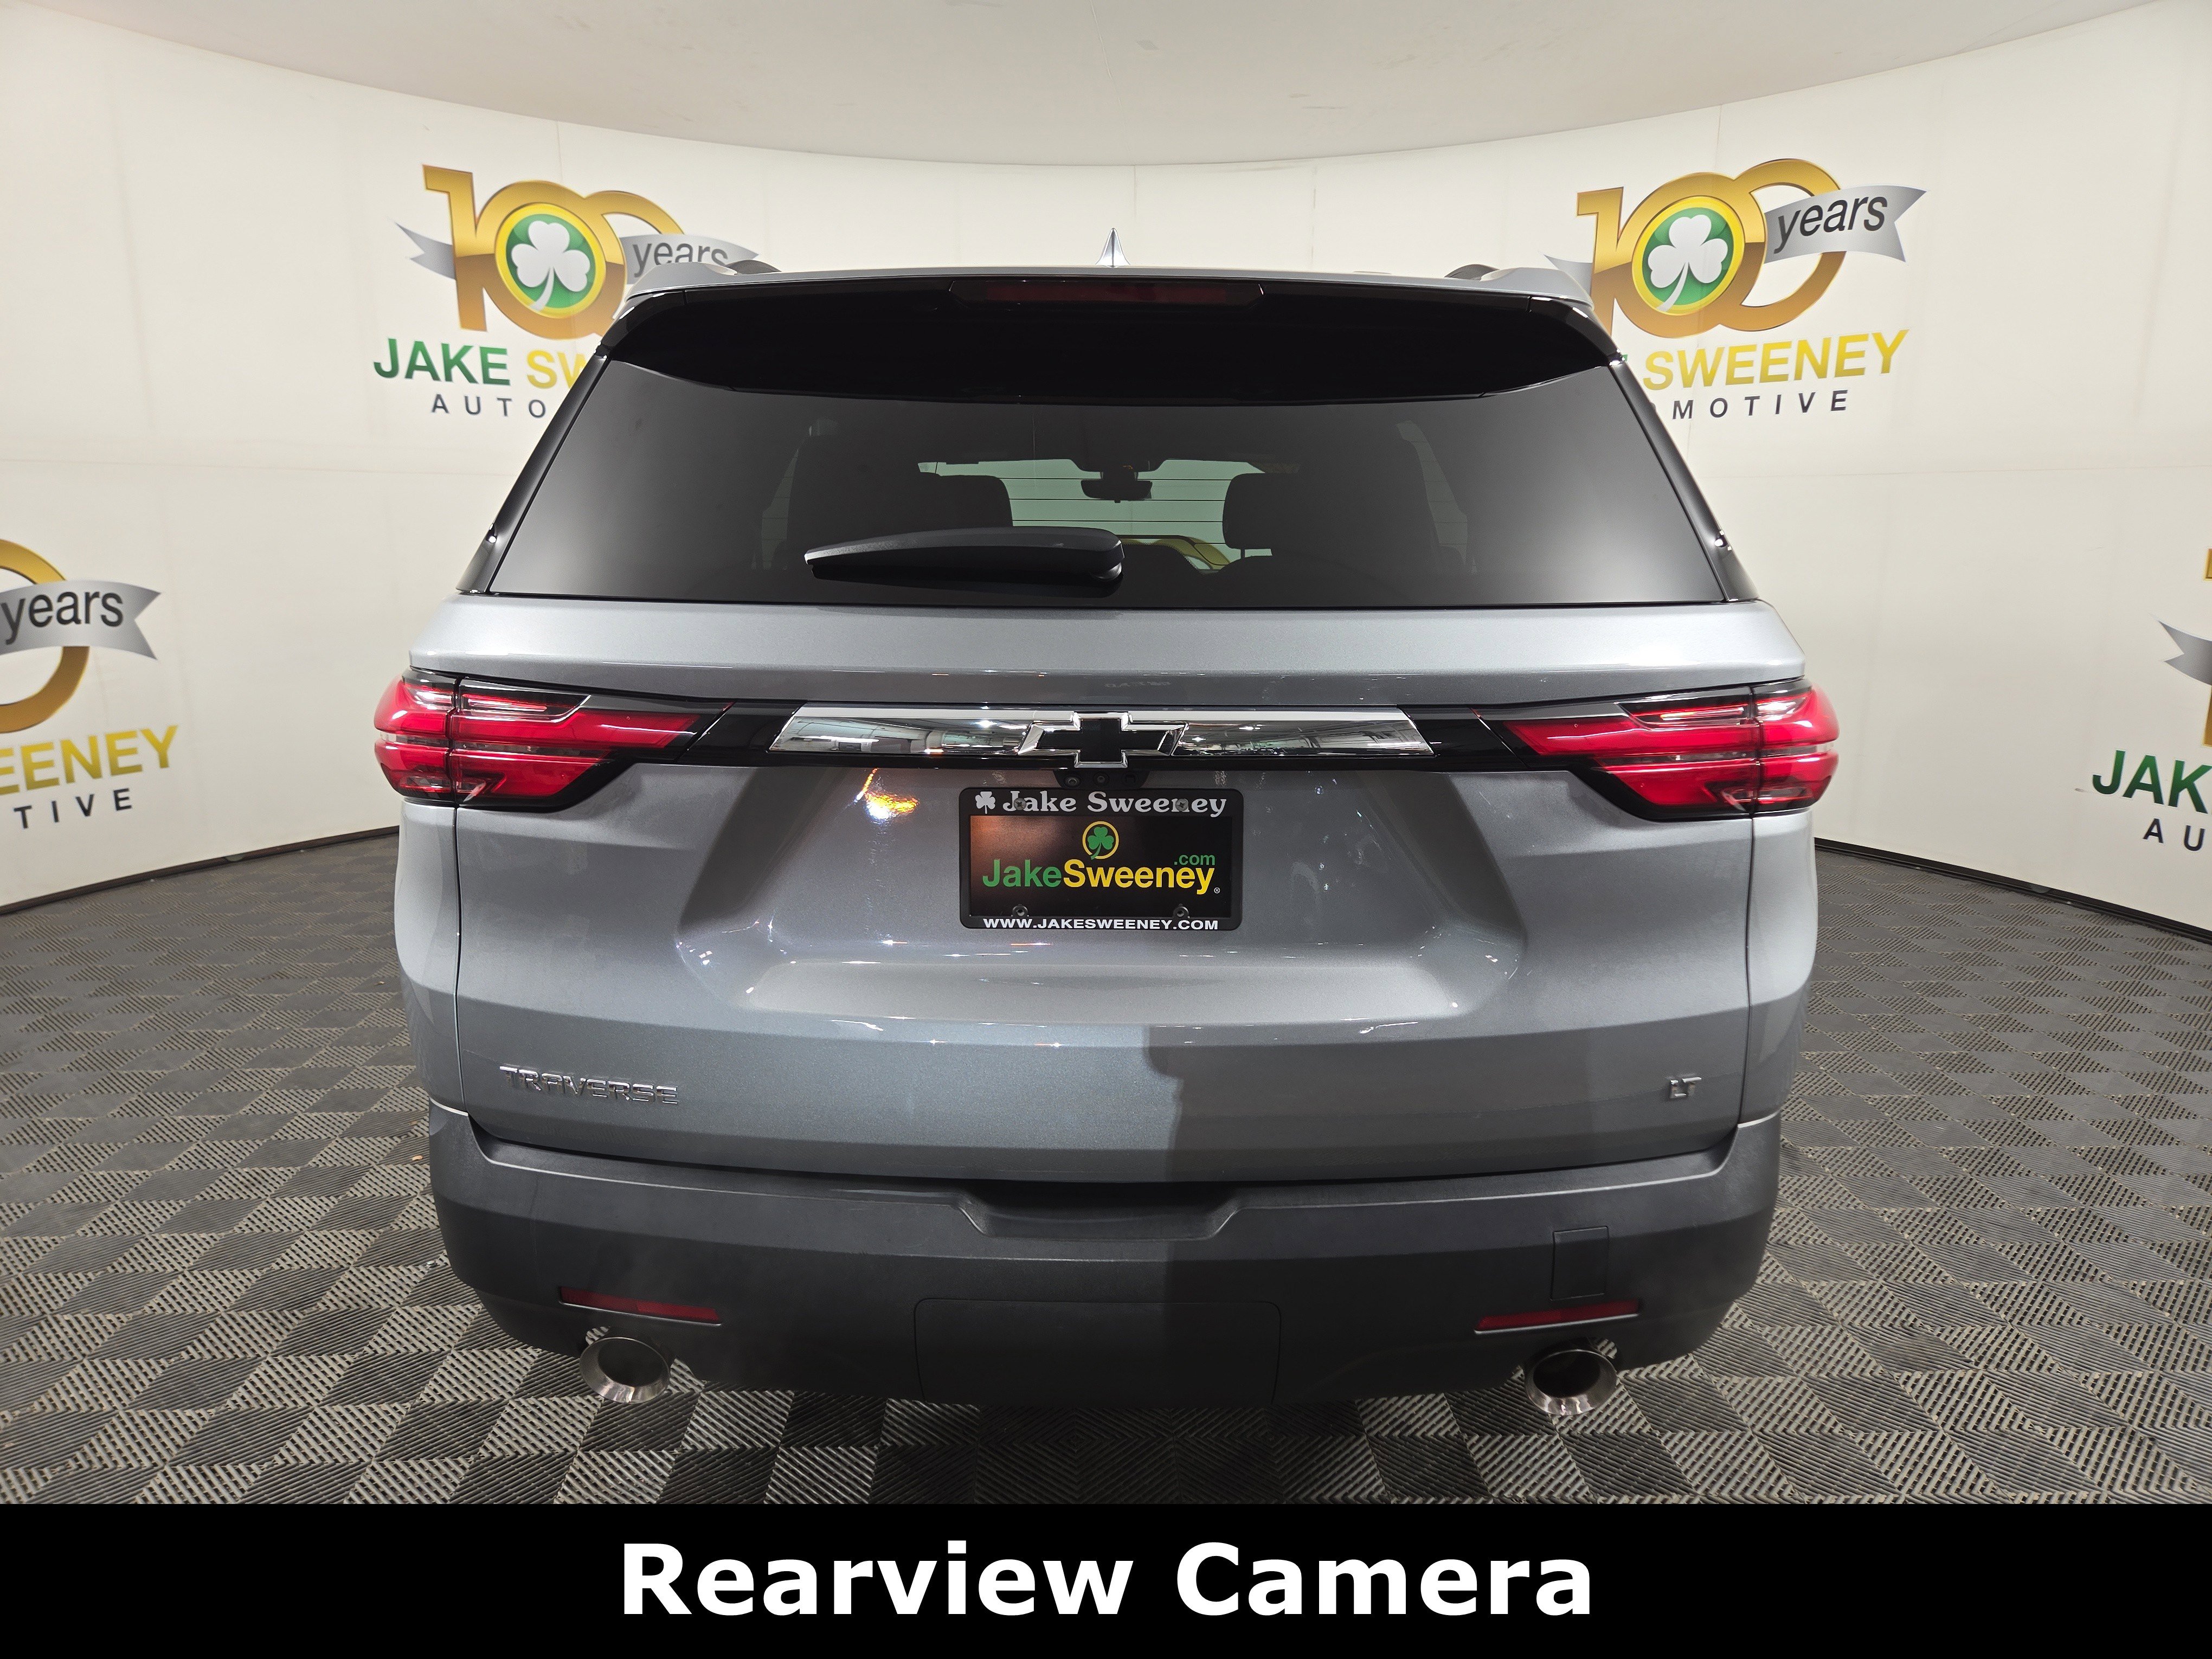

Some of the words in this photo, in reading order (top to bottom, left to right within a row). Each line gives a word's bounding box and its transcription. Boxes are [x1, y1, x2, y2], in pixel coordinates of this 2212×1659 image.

[1773, 196, 1888, 254] years
[374, 338, 511, 387] JAKE
[1643, 329, 1910, 391] SWEENEY
[1, 590, 124, 645] years
[1003, 790, 1077, 812] Jake
[983, 918, 1218, 930] WWW.JAKESWEENEY.COM
[499, 1065, 679, 1104] TRAVERSE
